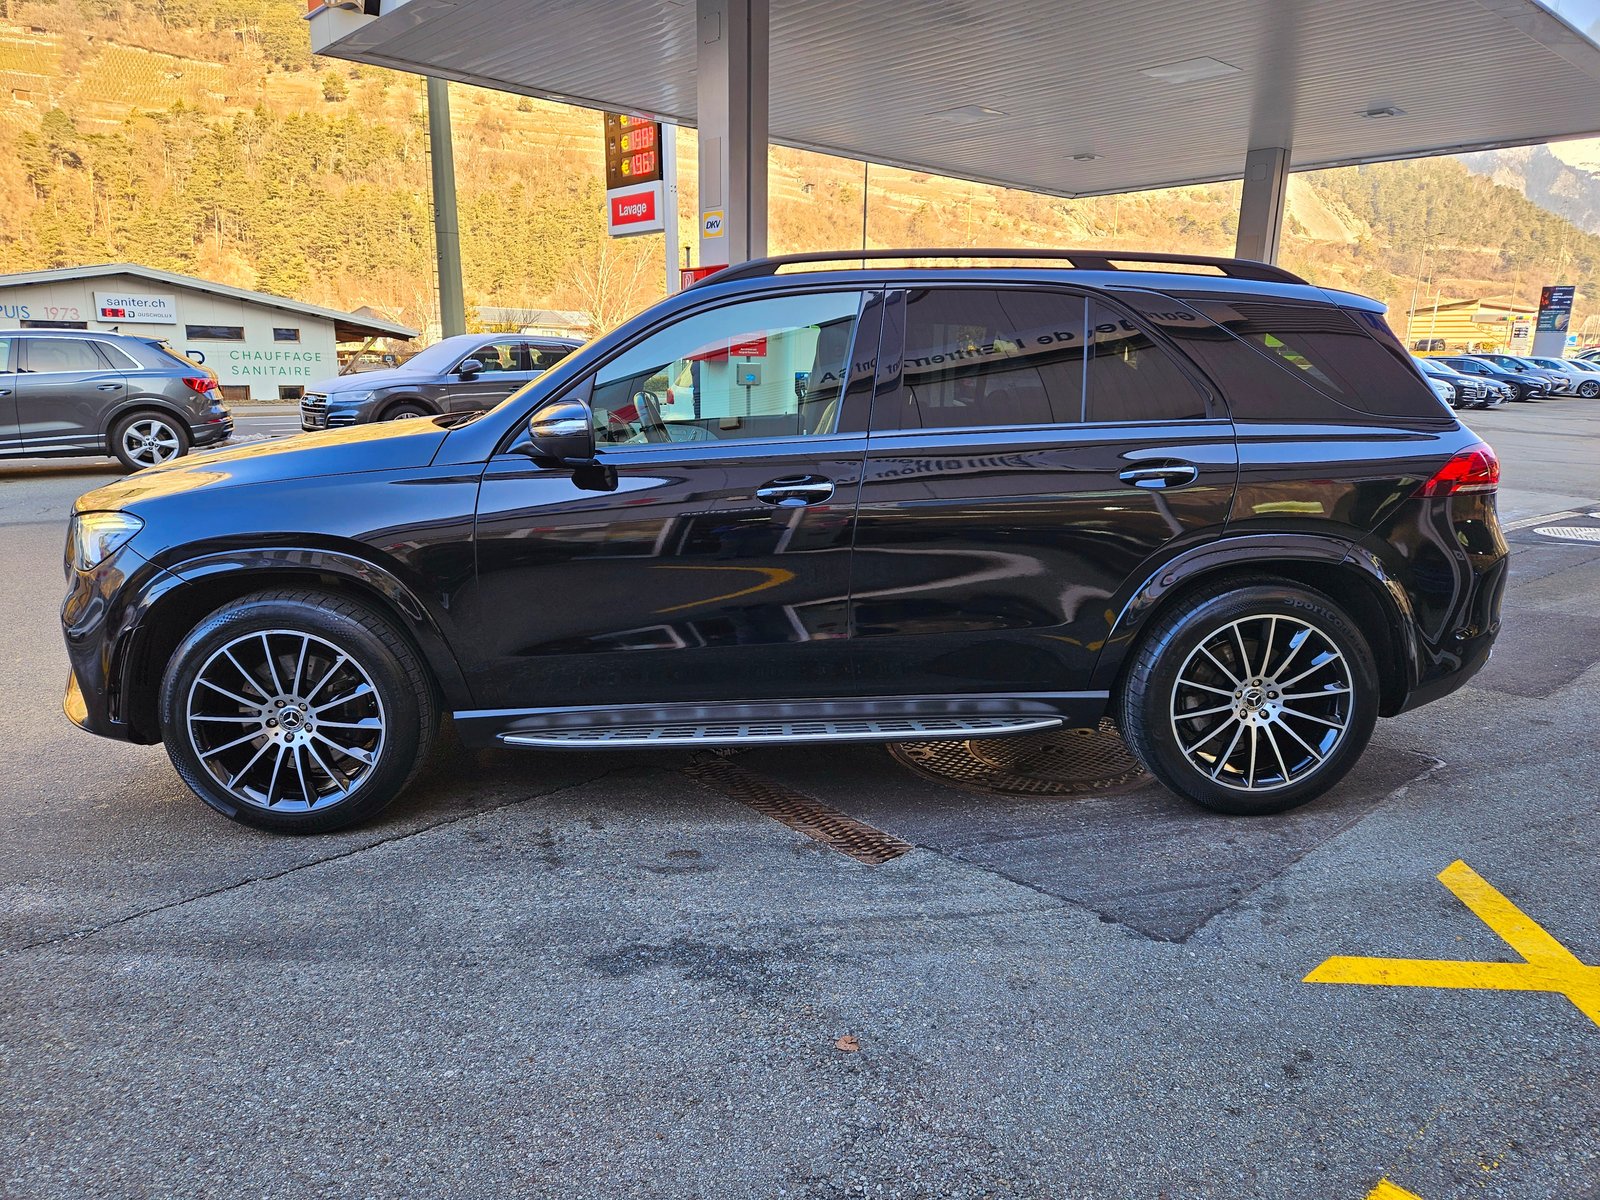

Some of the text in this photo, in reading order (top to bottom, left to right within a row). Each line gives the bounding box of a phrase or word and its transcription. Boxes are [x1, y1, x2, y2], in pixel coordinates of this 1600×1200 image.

[619, 203, 647, 216] Lavage
[706, 220, 721, 229] DKV
[107, 298, 166, 308] saniter.ch
[44, 306, 80, 320] 1973
[229, 350, 322, 362] CHAUFFAGE
[231, 365, 311, 376] SANITAIRE
